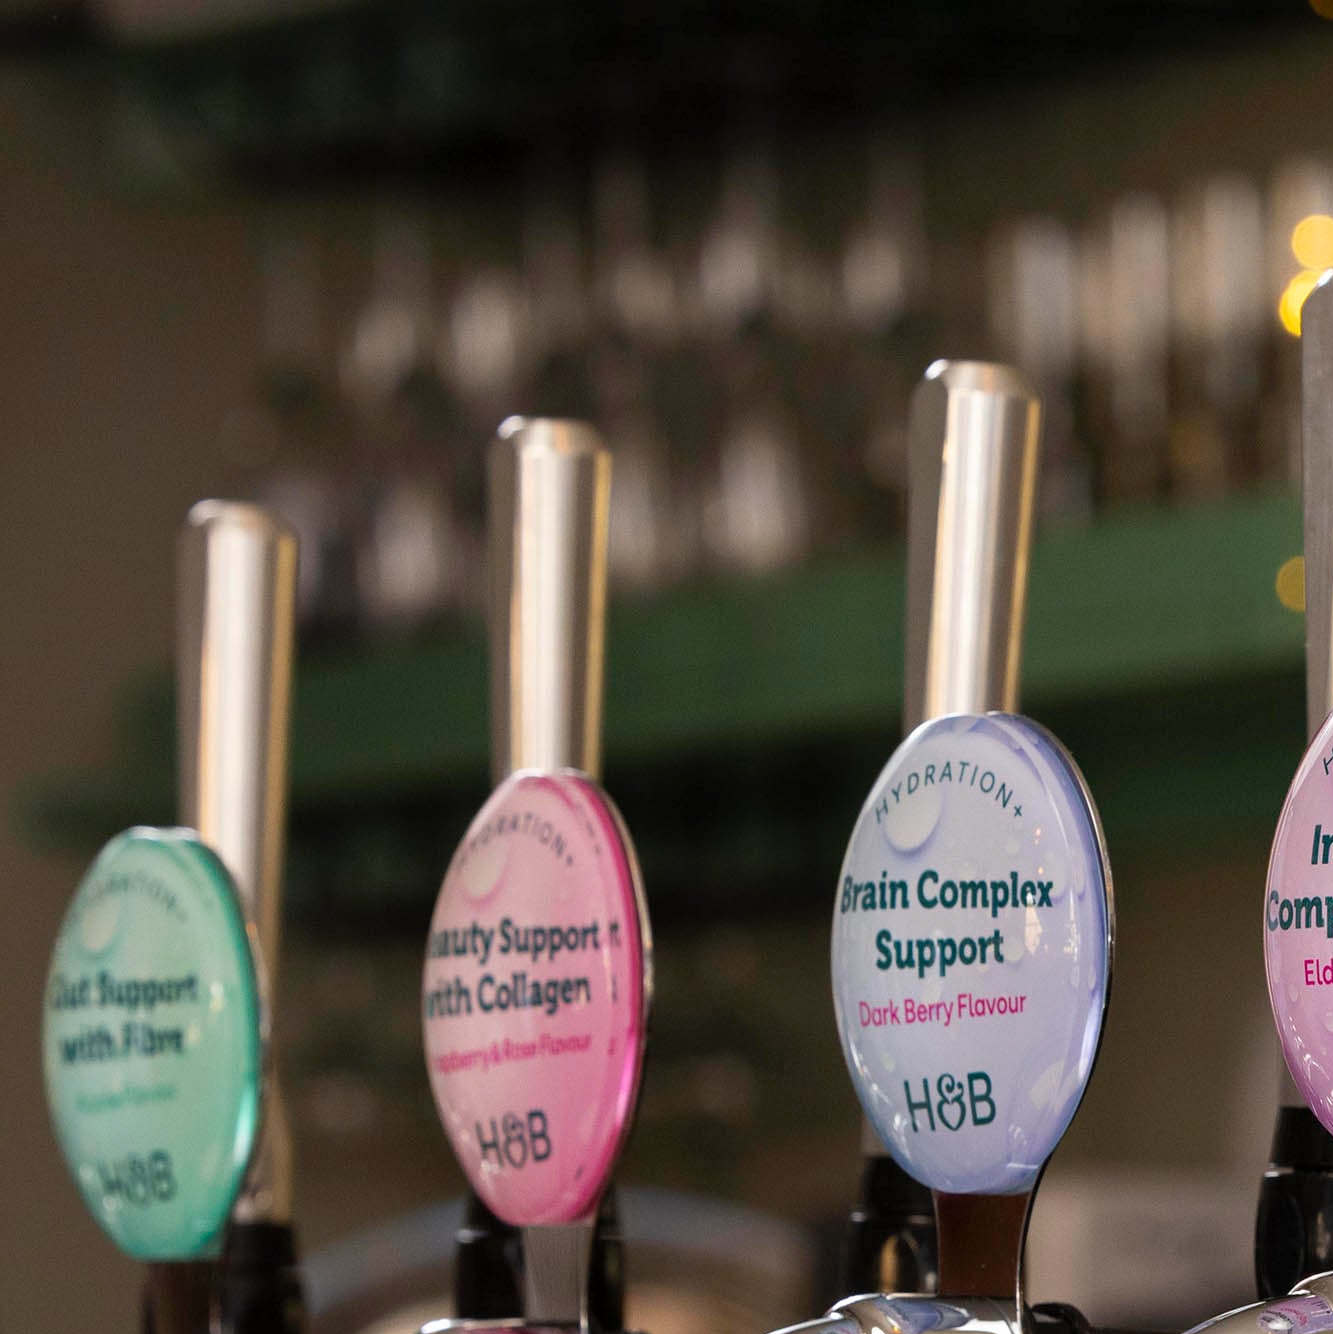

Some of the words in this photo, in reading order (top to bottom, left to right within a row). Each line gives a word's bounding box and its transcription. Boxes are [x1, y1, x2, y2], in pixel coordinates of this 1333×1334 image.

[841, 870, 909, 914] Brain
[917, 868, 1055, 919] Complex
[500, 917, 601, 962] Support
[875, 929, 1005, 979] Support
[478, 971, 592, 1015] Collagen
[859, 999, 900, 1029] Dark
[904, 996, 954, 1028] Berry
[957, 992, 1027, 1020] Flavour
[903, 1070, 998, 1133] H&B
[475, 1109, 553, 1170] H&B
